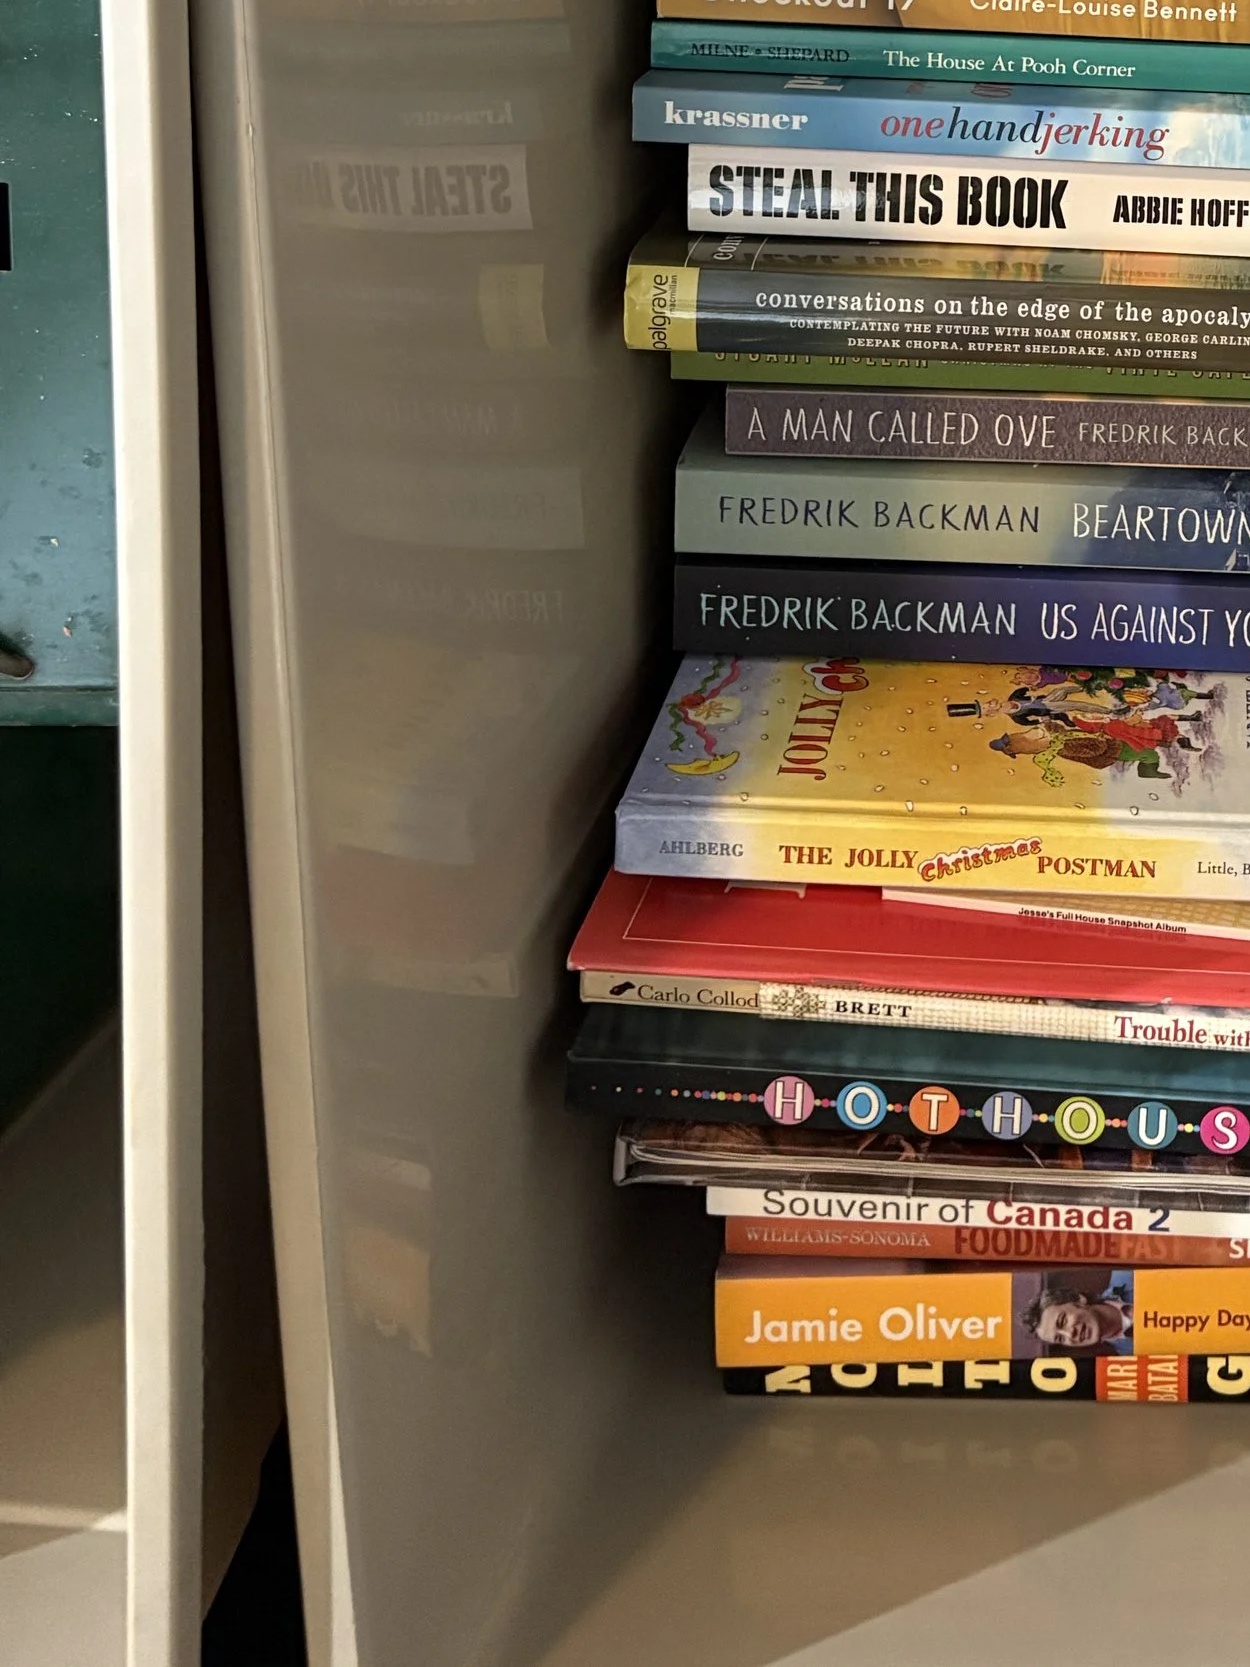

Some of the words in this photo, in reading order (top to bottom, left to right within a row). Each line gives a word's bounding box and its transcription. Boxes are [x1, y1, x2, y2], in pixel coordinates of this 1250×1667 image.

[883, 50, 920, 67] The
[926, 52, 985, 70] House
[991, 55, 1015, 72] At
[1021, 57, 1066, 75] Pooh
[1072, 59, 1136, 78] Corner
[663, 100, 808, 131] krassner
[880, 106, 1169, 160] onehandjerking
[708, 163, 841, 221] STEAL
[849, 170, 943, 226] THIS
[957, 175, 1068, 229] BOOK
[1113, 195, 1183, 226] ABBIE
[755, 291, 925, 315] conversations
[934, 299, 963, 316] on
[971, 297, 1008, 317] the
[1017, 298, 1074, 324] edge
[1079, 301, 1105, 320] of
[1115, 303, 1153, 323] the
[747, 407, 767, 441] A
[782, 408, 852, 443] MAN
[868, 410, 979, 446] CALLED
[994, 413, 1056, 448] OVE
[719, 496, 859, 529] FREDRIK
[874, 500, 1040, 533] BACKMAN
[1041, 602, 1078, 641] US
[1091, 602, 1215, 646] AGAINST
[658, 839, 744, 857] AHLBERG
[779, 844, 833, 866] THE
[844, 847, 919, 869] JOLLY
[920, 837, 1043, 882] Christmas
[1037, 856, 1157, 879] POSTMAN
[1197, 861, 1238, 877] Little,
[1018, 906, 1055, 919] Jesse's
[1056, 910, 1073, 921] Full
[1075, 914, 1106, 924] House
[1108, 917, 1154, 930] Snapshot
[1156, 921, 1187, 933] Album
[834, 999, 913, 1018] BRETT
[1114, 1015, 1208, 1046] Trouble
[762, 1189, 930, 1223] Souvenir
[938, 1200, 974, 1224] of
[986, 1199, 1134, 1231] Canada
[1147, 1206, 1171, 1232] 2
[744, 1307, 863, 1344] Jamie
[878, 1303, 1003, 1342] Oliver
[1143, 1309, 1210, 1333] Happy
